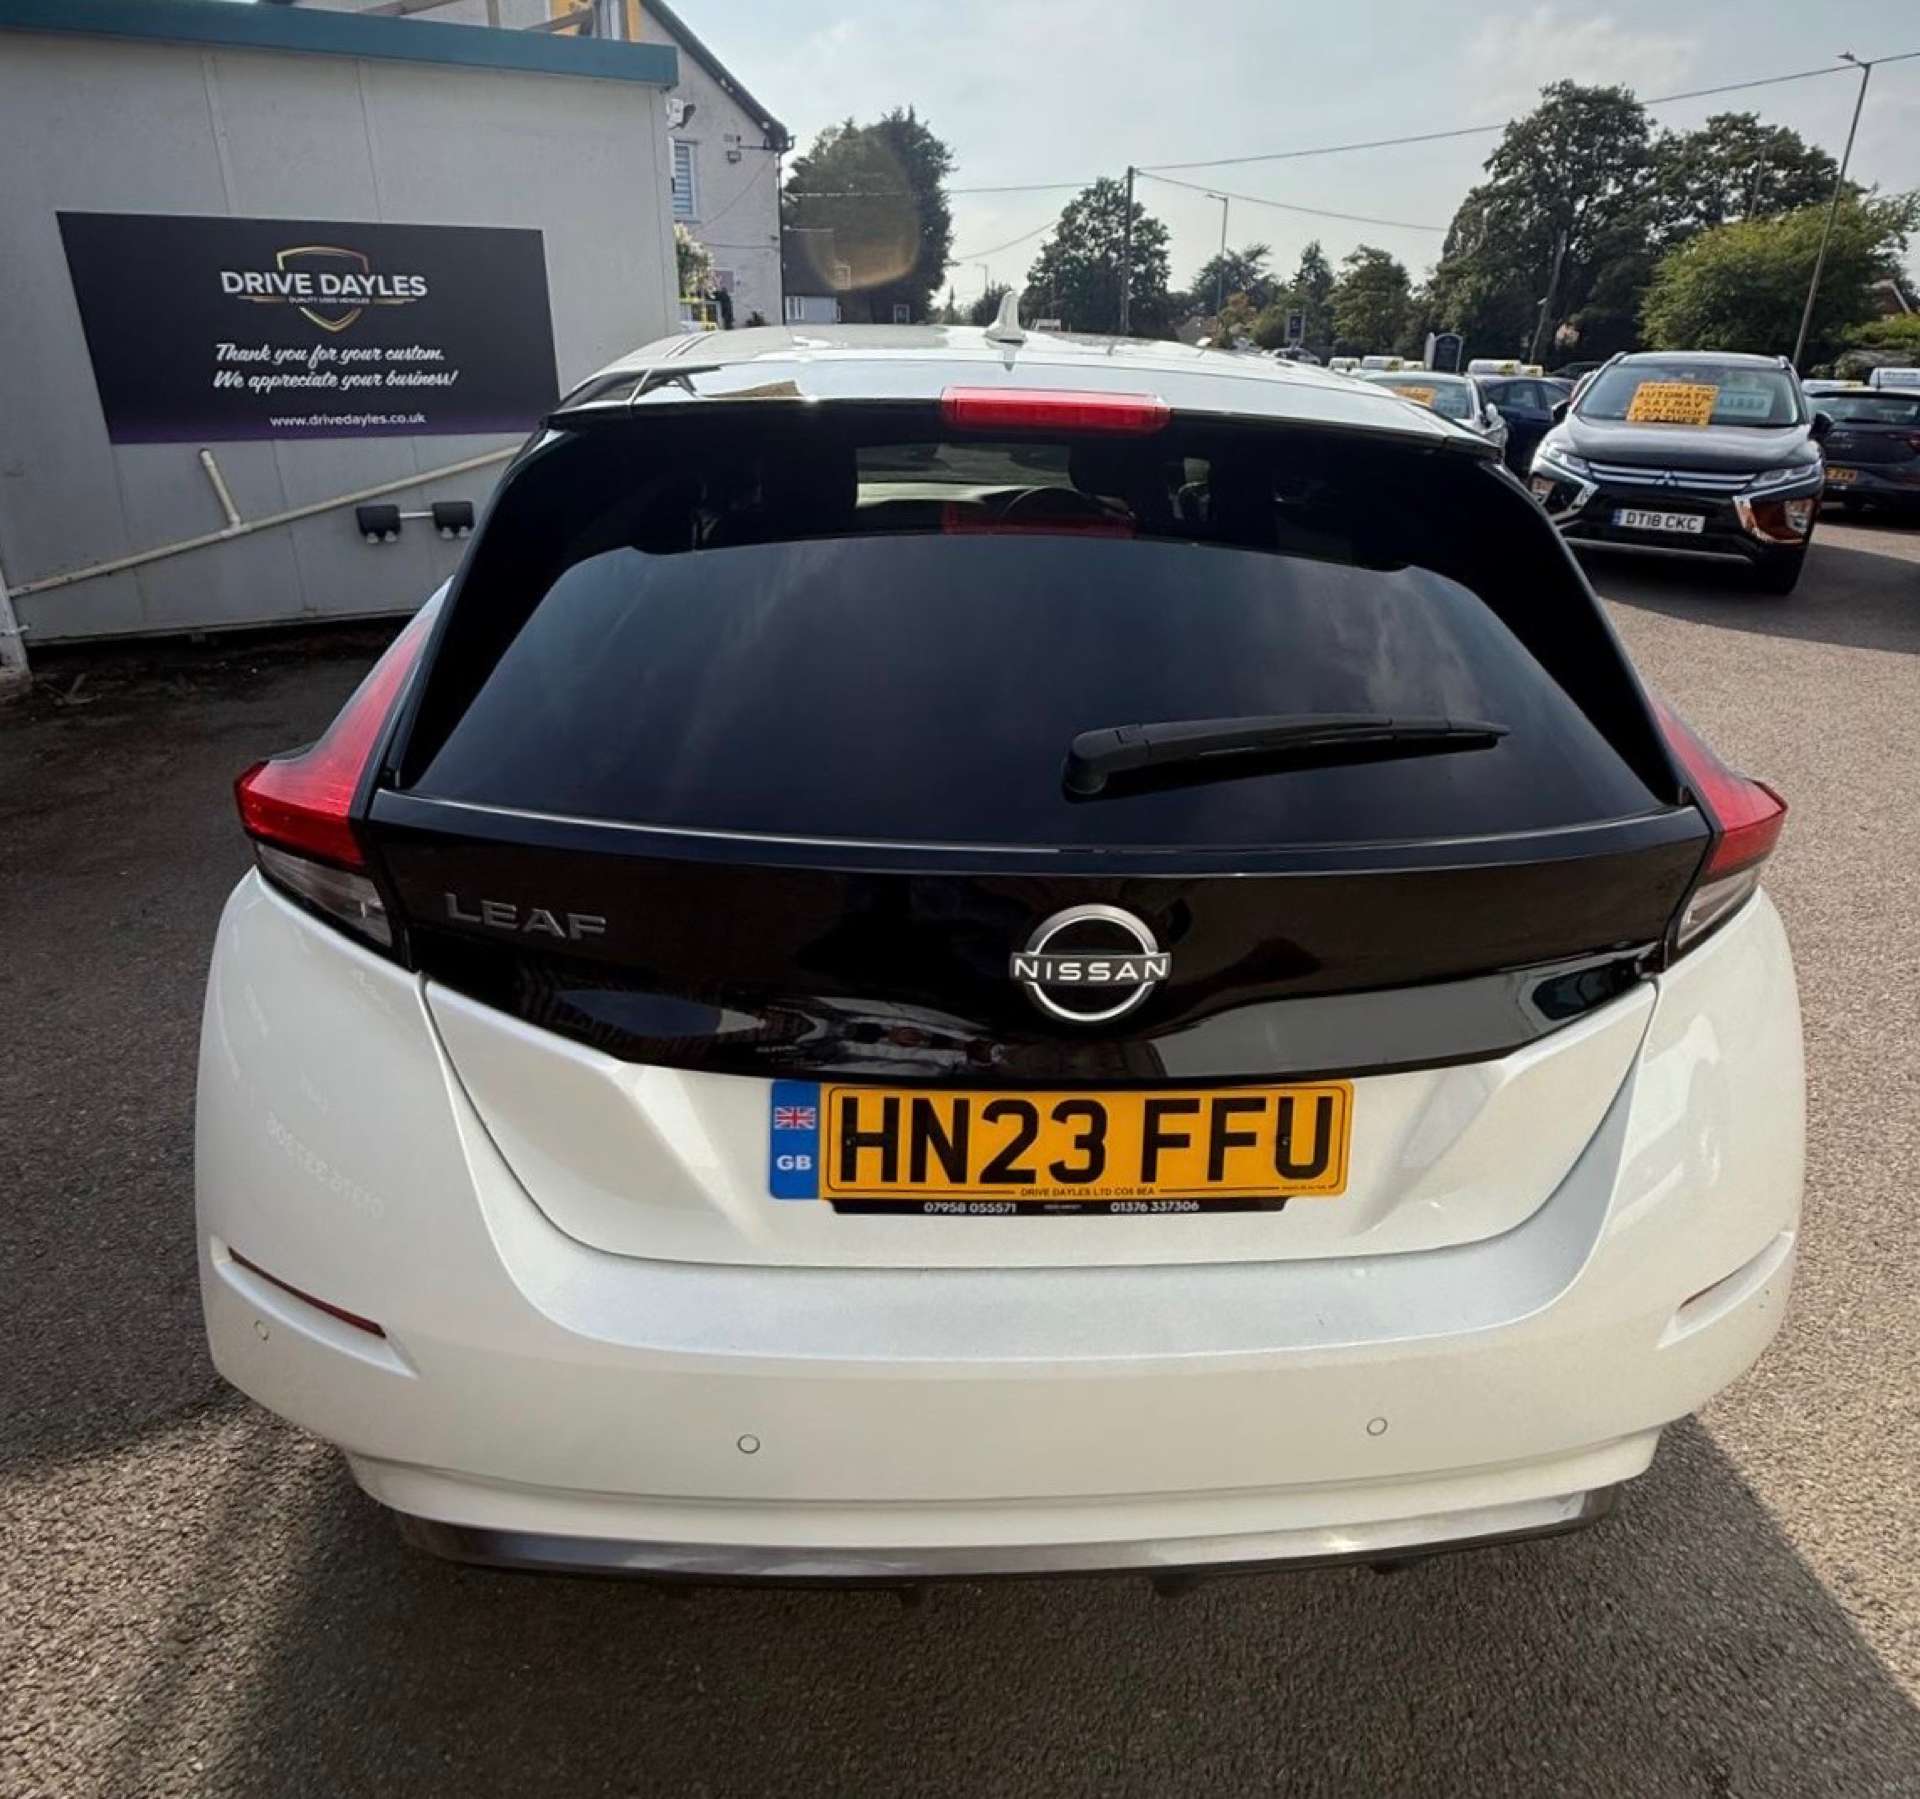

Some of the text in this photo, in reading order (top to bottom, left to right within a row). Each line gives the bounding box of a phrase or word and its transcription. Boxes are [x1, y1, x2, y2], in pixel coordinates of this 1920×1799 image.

[220, 271, 428, 297] DRIVE DAYLES
[215, 343, 444, 369] Thank you for your custom.
[212, 370, 460, 394] We appreciate your business!
[1637, 391, 1714, 400] AUTOMATIC
[1674, 400, 1704, 408] NAV
[269, 412, 426, 428] www.drivedayles.co.uk
[1626, 511, 1698, 531] DT18 CKC
[444, 891, 607, 940] LEAF
[1013, 957, 1168, 982] NISSAN
[838, 1094, 1333, 1184] HN23 FFU
[776, 1154, 812, 1171] GB
[1020, 1187, 1049, 1196] DRIVE
[1055, 1187, 1090, 1196] DAYLES
[1094, 1187, 1112, 1196] LTD
[924, 1201, 1017, 1213] 07958 055571
[1110, 1201, 1200, 1213] 01376 337306
